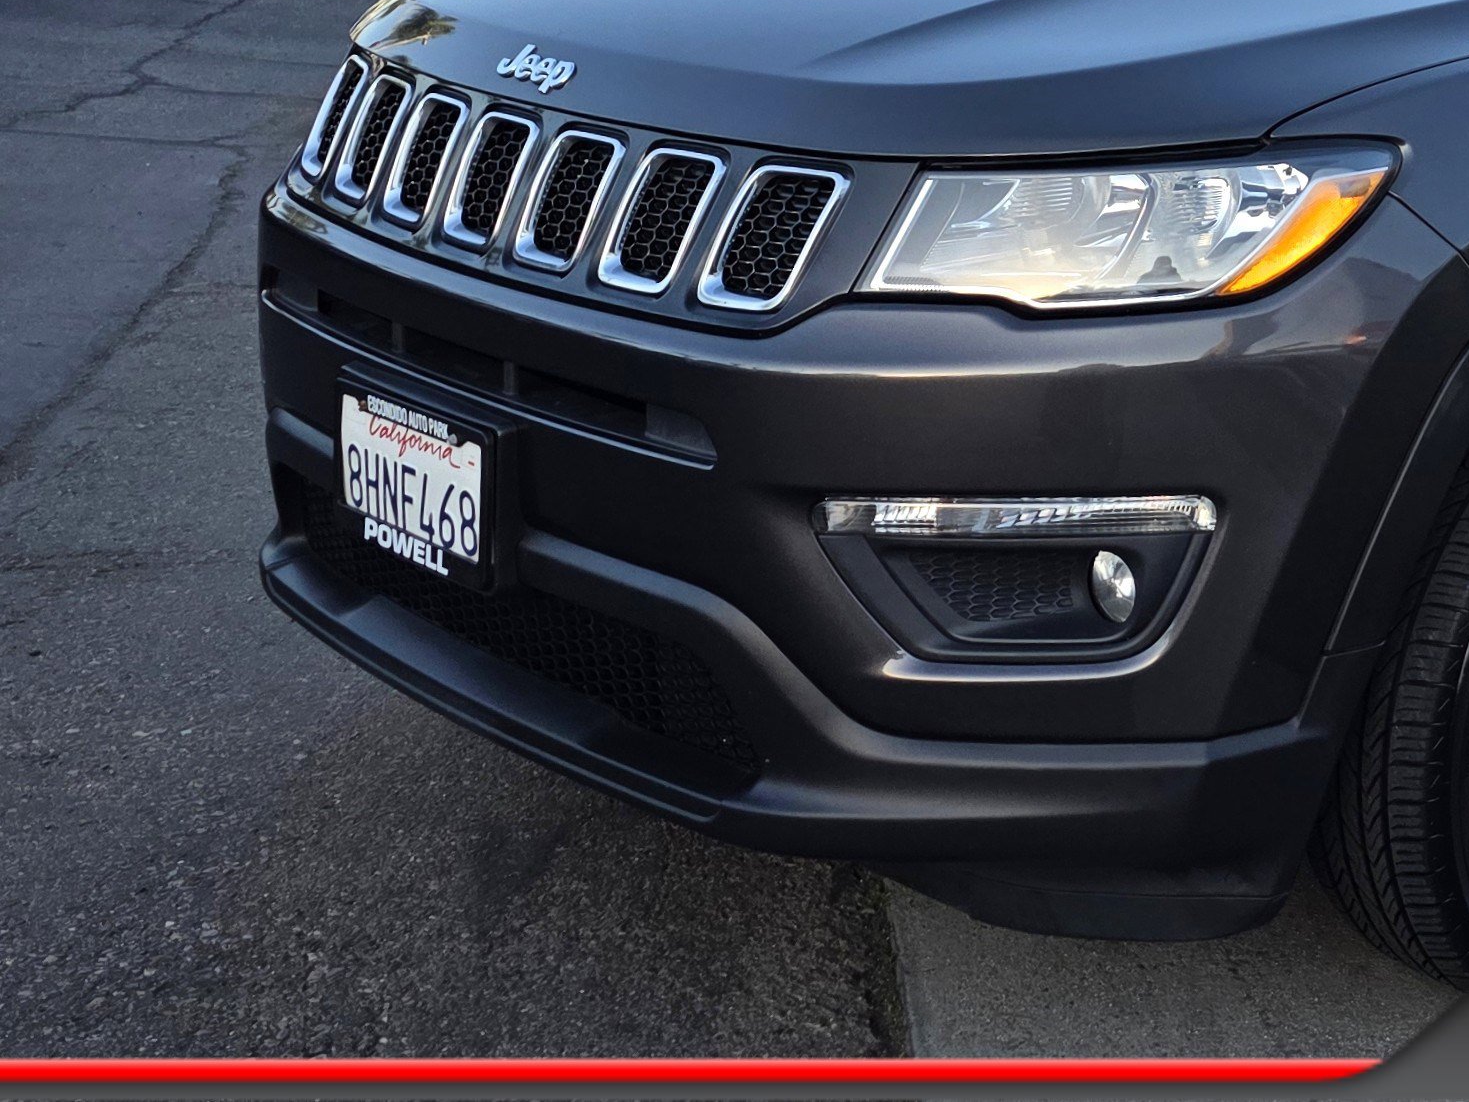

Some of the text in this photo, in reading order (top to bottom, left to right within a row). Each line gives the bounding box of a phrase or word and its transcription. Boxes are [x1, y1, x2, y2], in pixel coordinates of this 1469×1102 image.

[496, 44, 576, 94] Jeep
[369, 416, 461, 468] California
[364, 516, 449, 576] POWELL
